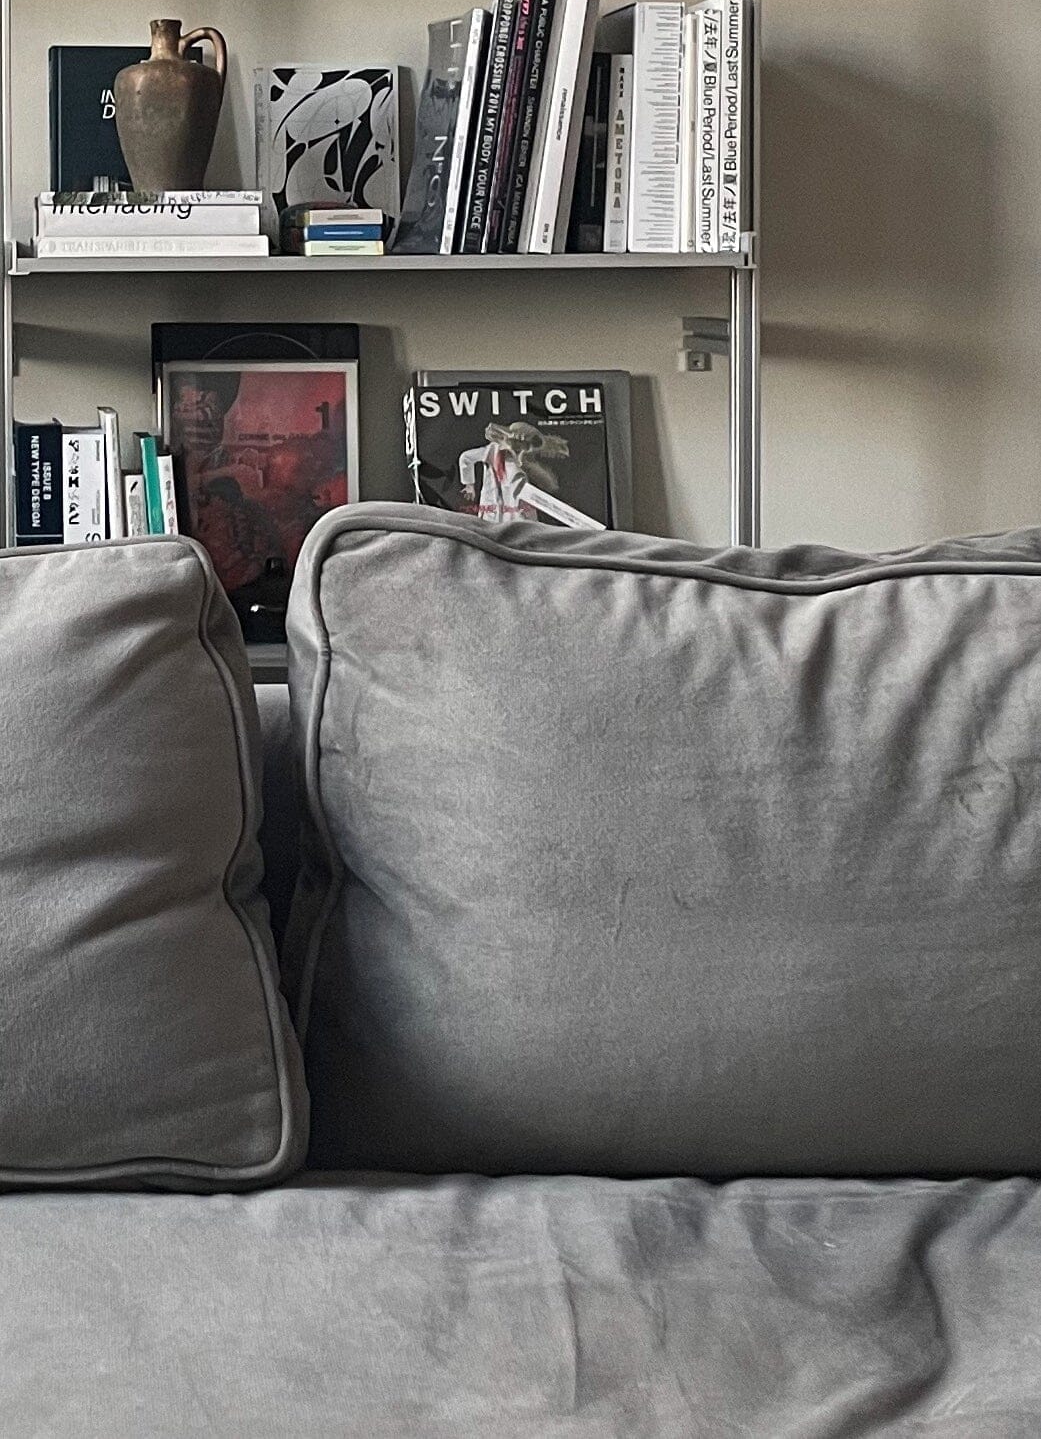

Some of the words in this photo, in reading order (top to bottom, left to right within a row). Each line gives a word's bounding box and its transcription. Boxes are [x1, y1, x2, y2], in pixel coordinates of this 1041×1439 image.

[537, 8, 548, 39] PUBLIC
[725, 0, 740, 59] Summer
[490, 45, 507, 90] CROSSING
[529, 39, 544, 90] CHARACTER
[703, 75, 717, 107] Blue
[484, 117, 495, 133] MY
[556, 88, 568, 142] renaissance
[614, 109, 625, 209] AMETORA
[723, 140, 737, 171] Blue
[474, 167, 488, 196] YOUR
[470, 198, 483, 230] VOICE
[701, 186, 715, 246] Summer
[419, 388, 603, 418] SWITCH
[30, 435, 40, 458] NEW
[30, 459, 40, 487] TYPE
[42, 461, 52, 492] ISSUE
[30, 488, 41, 528] DESIGN
